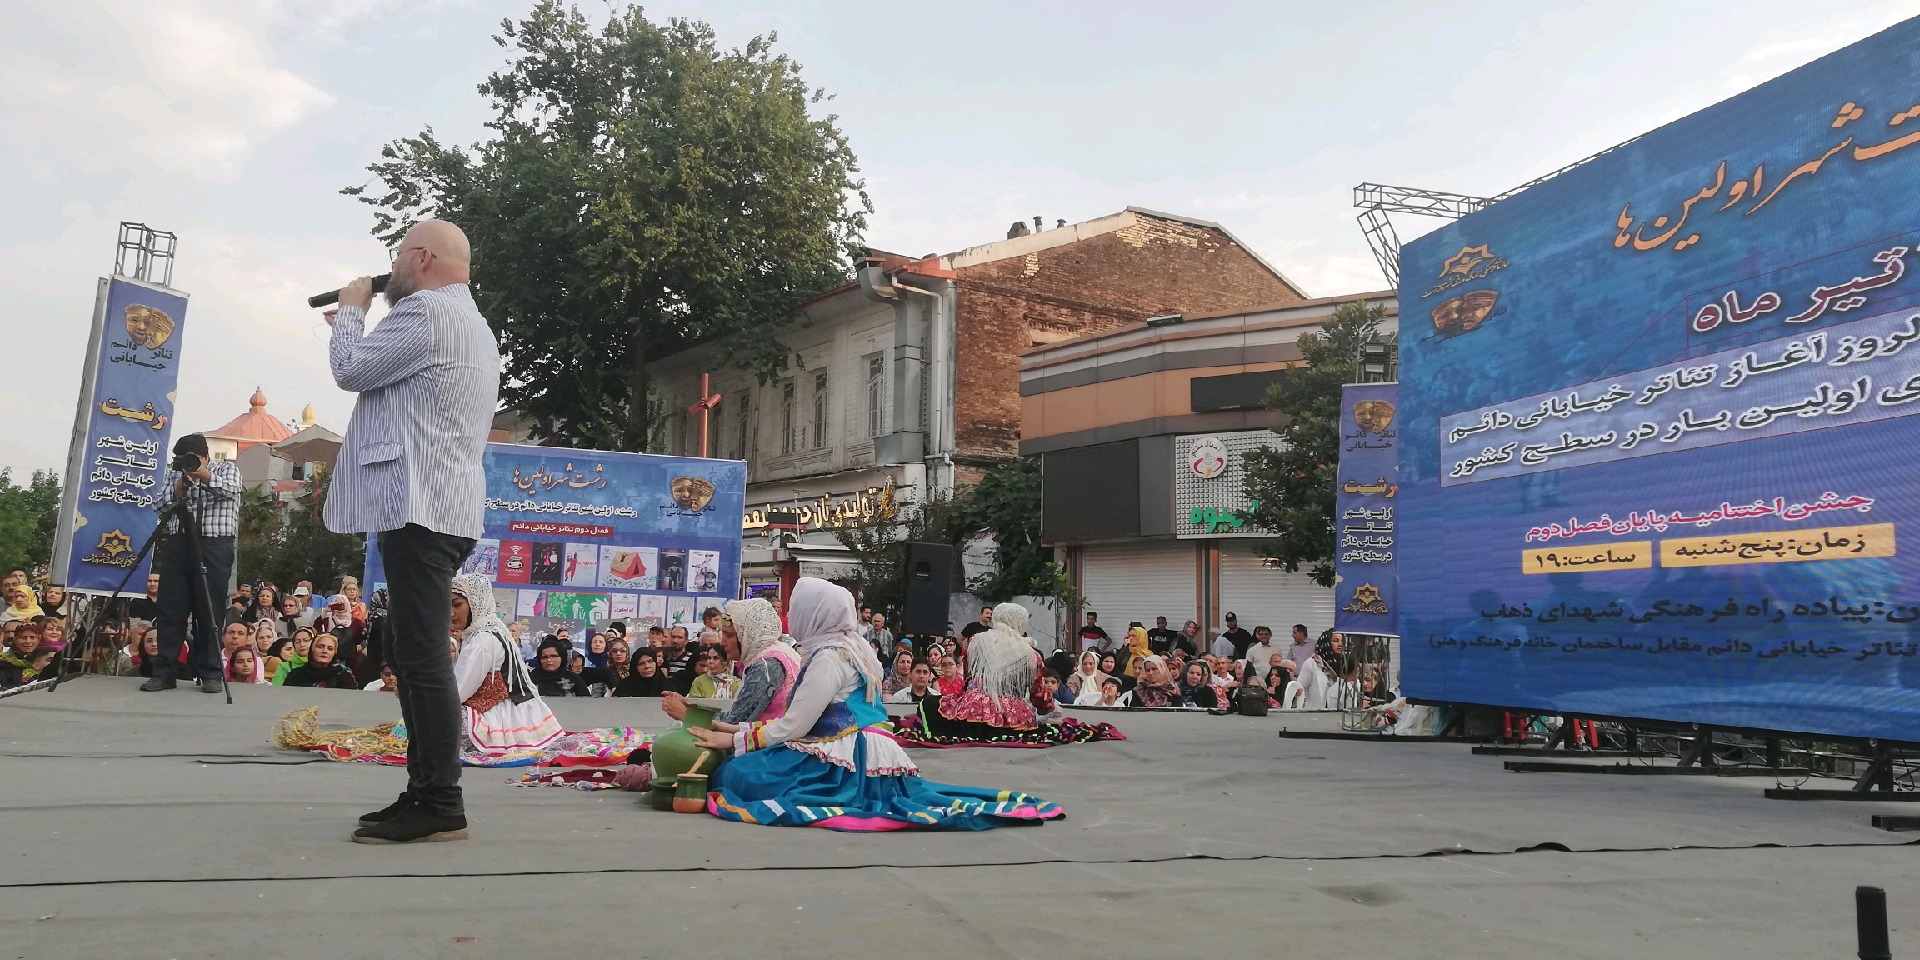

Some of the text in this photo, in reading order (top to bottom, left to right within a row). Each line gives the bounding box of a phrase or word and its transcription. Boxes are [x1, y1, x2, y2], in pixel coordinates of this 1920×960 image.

[1746, 101, 1864, 216] شهر
[1633, 161, 1764, 251] اولین
[1693, 247, 1908, 332] تیر ماه
[1721, 332, 1827, 387] آغاز
[1636, 363, 1718, 405] تئاتر
[1514, 384, 1636, 429] خیابانی
[1737, 375, 1872, 428] اولین
[101, 398, 165, 430] رشت
[1661, 408, 1732, 442] بار
[1450, 410, 1512, 442] دائم
[1619, 421, 1658, 449] در
[97, 435, 159, 455] اولین شهر
[1521, 432, 1617, 463] سطح
[95, 455, 157, 470] تئاتر
[1449, 442, 1517, 477] کشور
[91, 467, 154, 489] خیابانی دائم
[569, 463, 607, 489] رشت
[1344, 477, 1396, 498] رشت
[89, 487, 152, 507] در سطح کشور
[1342, 507, 1393, 520] اولین شهر
[1525, 491, 1875, 542] جشن اختتامیه پایان فصل دوم
[1343, 522, 1393, 533] تئاتر
[1358, 536, 1394, 548] خیابانی
[1342, 550, 1363, 562] کشور
[1381, 551, 1392, 563] در
[1537, 602, 1624, 623] شهدای
[1630, 597, 1740, 623] فرهنگی
[1745, 598, 1786, 623] راه
[1469, 635, 1522, 651] فرهنگ
[1523, 636, 1558, 649] خانه
[1562, 636, 1643, 653] ساختمان
[1648, 637, 1703, 654] مقابل
[1707, 638, 1753, 657] دائم
[1757, 639, 1847, 658] خیابانی
